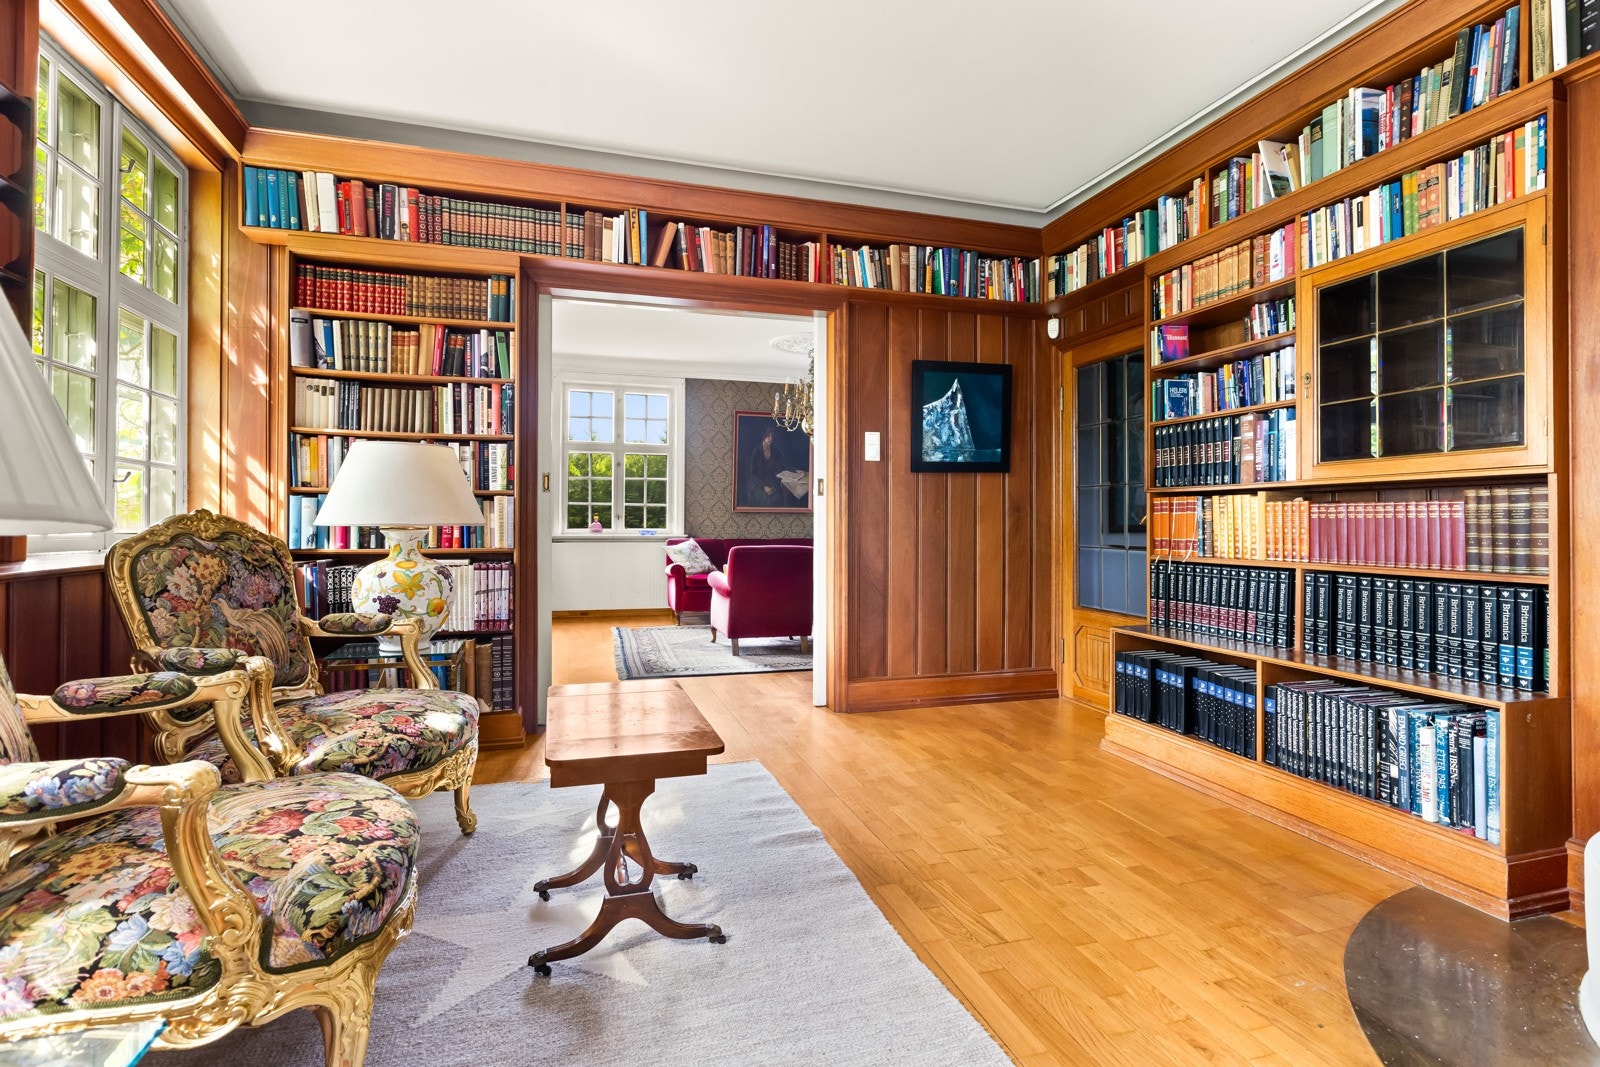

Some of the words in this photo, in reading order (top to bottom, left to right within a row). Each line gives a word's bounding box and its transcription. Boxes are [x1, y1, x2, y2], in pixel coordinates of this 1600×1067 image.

[1467, 600, 1475, 636] Britannica
[1484, 602, 1492, 638] Britannica
[1502, 603, 1511, 641] Britannica
[1521, 605, 1529, 643] Britannica
[1398, 715, 1406, 744] EDVARD
[1488, 716, 1496, 733] ART
[1449, 730, 1457, 753] Henrik
[1399, 746, 1407, 770] GRIEG
[1437, 749, 1445, 770] ETTER
